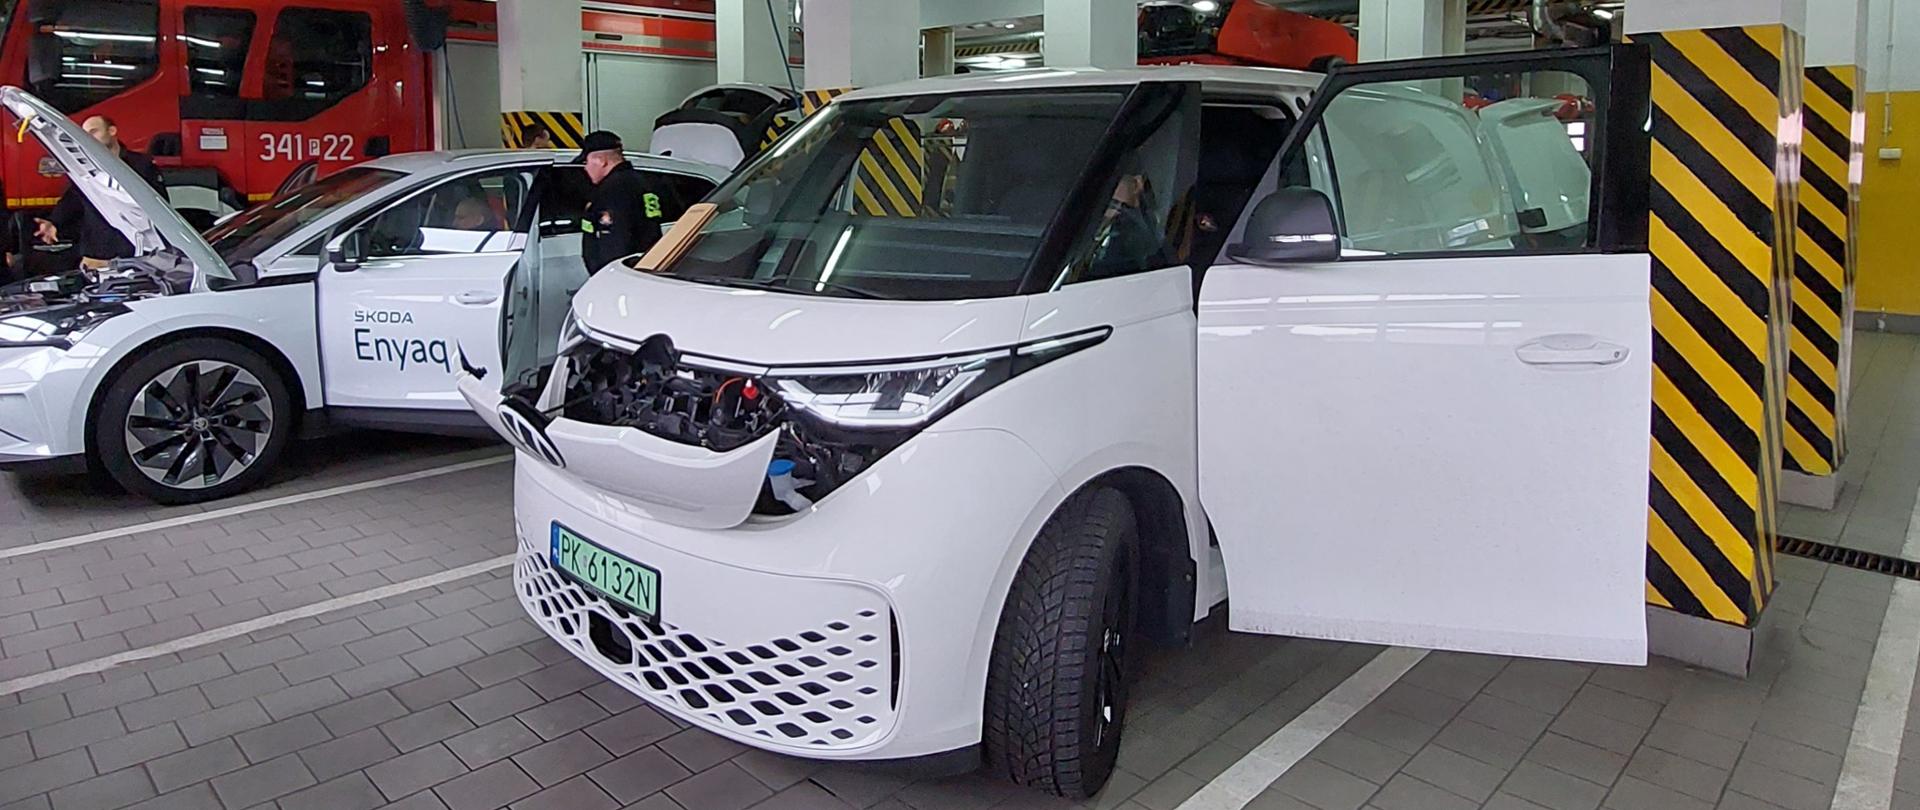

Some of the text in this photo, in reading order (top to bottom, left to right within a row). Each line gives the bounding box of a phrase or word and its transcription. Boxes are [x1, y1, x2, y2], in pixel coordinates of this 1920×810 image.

[259, 133, 354, 161] 341 P 22
[354, 328, 451, 374] Enyaq
[561, 533, 650, 610] PK 6132N
